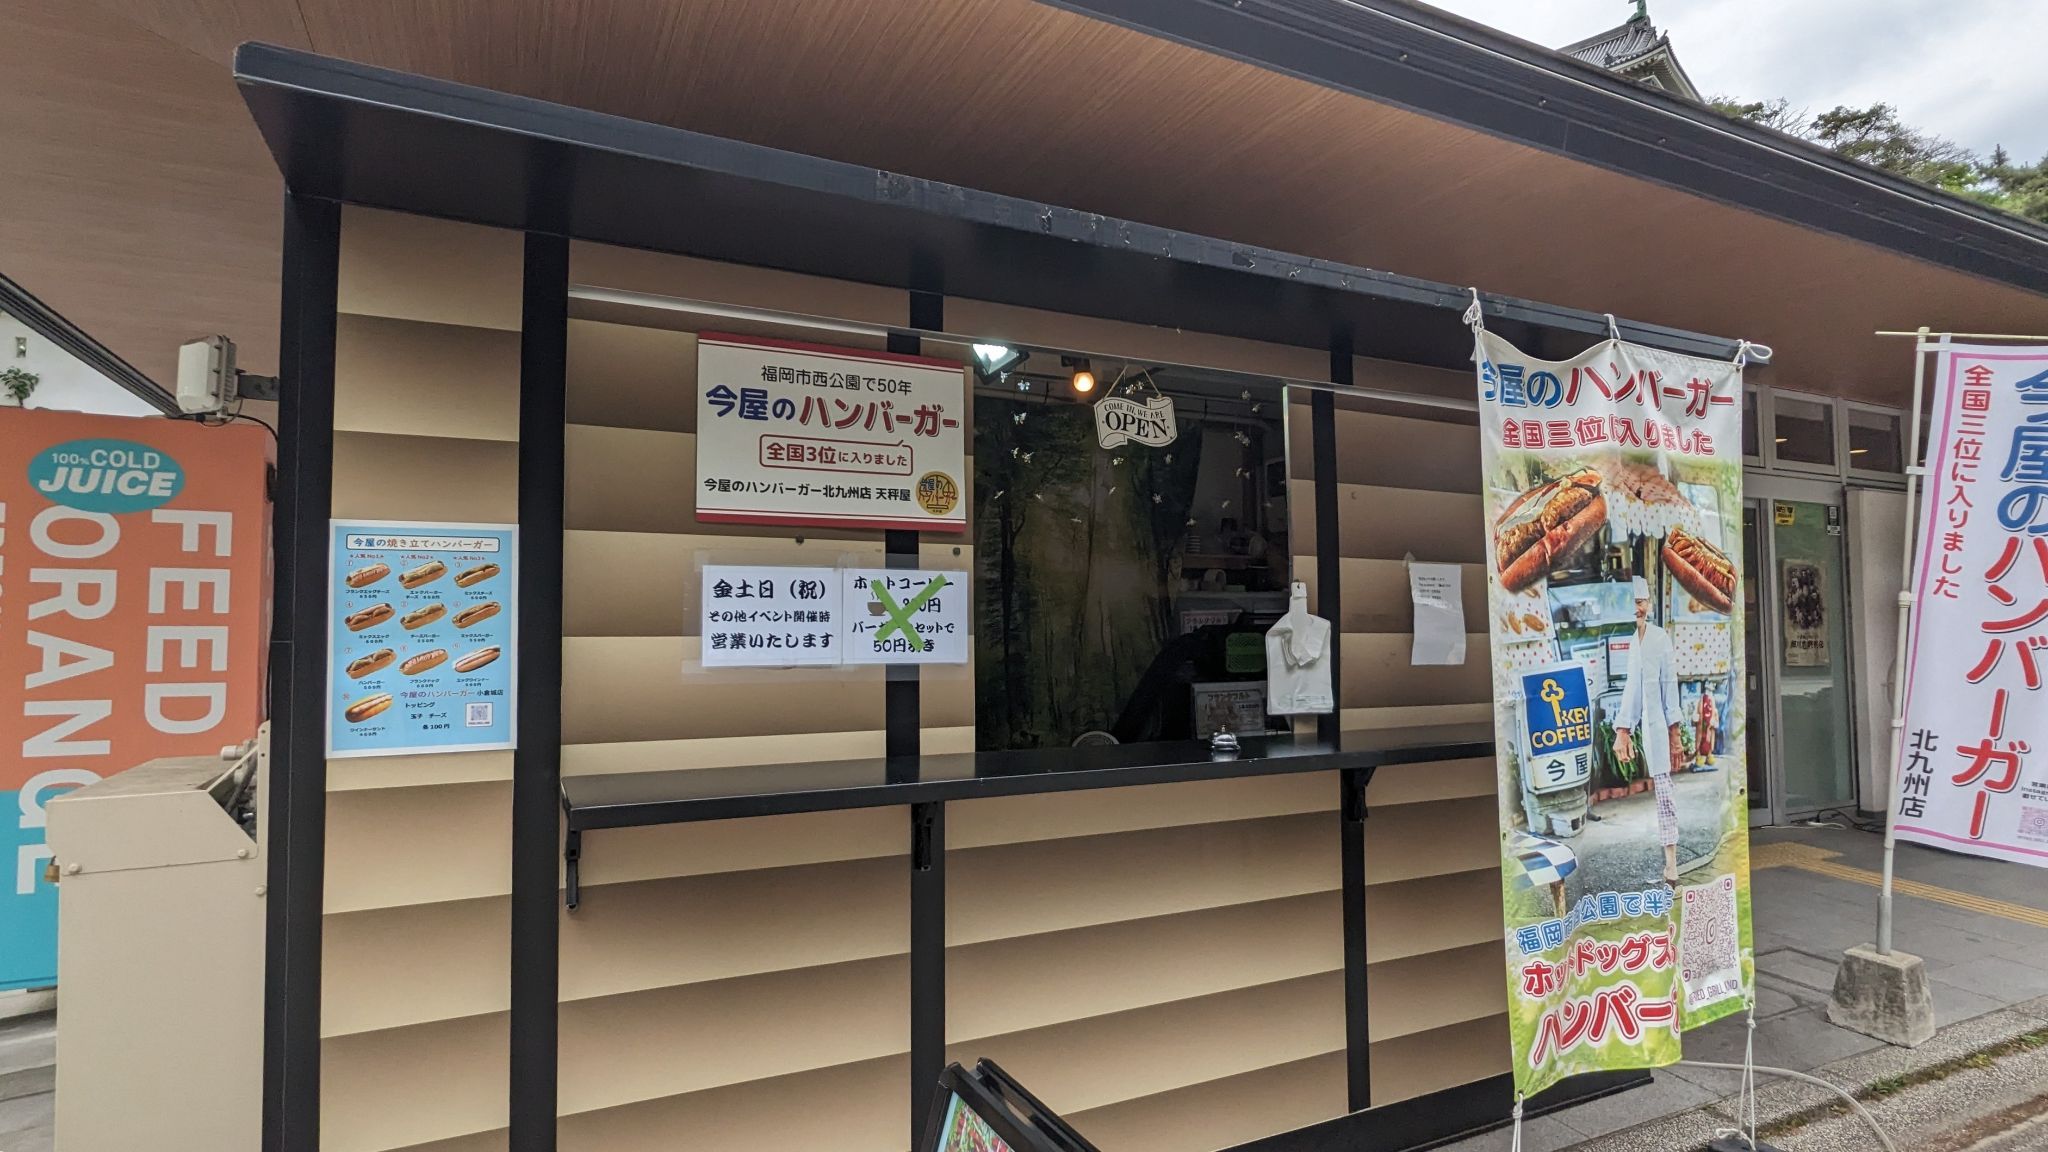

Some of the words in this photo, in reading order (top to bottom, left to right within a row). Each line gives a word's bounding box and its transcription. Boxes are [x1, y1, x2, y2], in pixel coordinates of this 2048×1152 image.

[760, 365, 913, 396] 福岡市西公園で50年
[705, 384, 960, 437] 今屋のハンバーガー
[1104, 402, 1123, 411] COME
[1138, 409, 1148, 417] WE
[1150, 411, 1163, 419] ARE
[1105, 411, 1168, 438] OPEN
[1501, 413, 1716, 455] 全国三位に入りました
[91, 449, 161, 469] COLD
[766, 442, 908, 467] 全国3位に入りました
[38, 466, 177, 497] JUICE
[704, 477, 872, 500] 今屋のハンバーガー北九州店
[876, 486, 912, 502] 天秤屋
[1933, 364, 1994, 600] 全国三位に入りました
[353, 536, 494, 549] 今屋の焼き立てハンバーガー
[854, 575, 954, 590] ホトコーー
[144, 509, 233, 734] FEED
[708, 610, 831, 623] その他イベント開催時
[711, 632, 834, 650] 営業いたします
[873, 637, 935, 652] 50円き
[1561, 705, 1590, 724] KEY
[1532, 723, 1591, 749] COFFEE
[1898, 729, 1940, 819] 北九州店
[1534, 985, 1681, 1064] ハンバー
